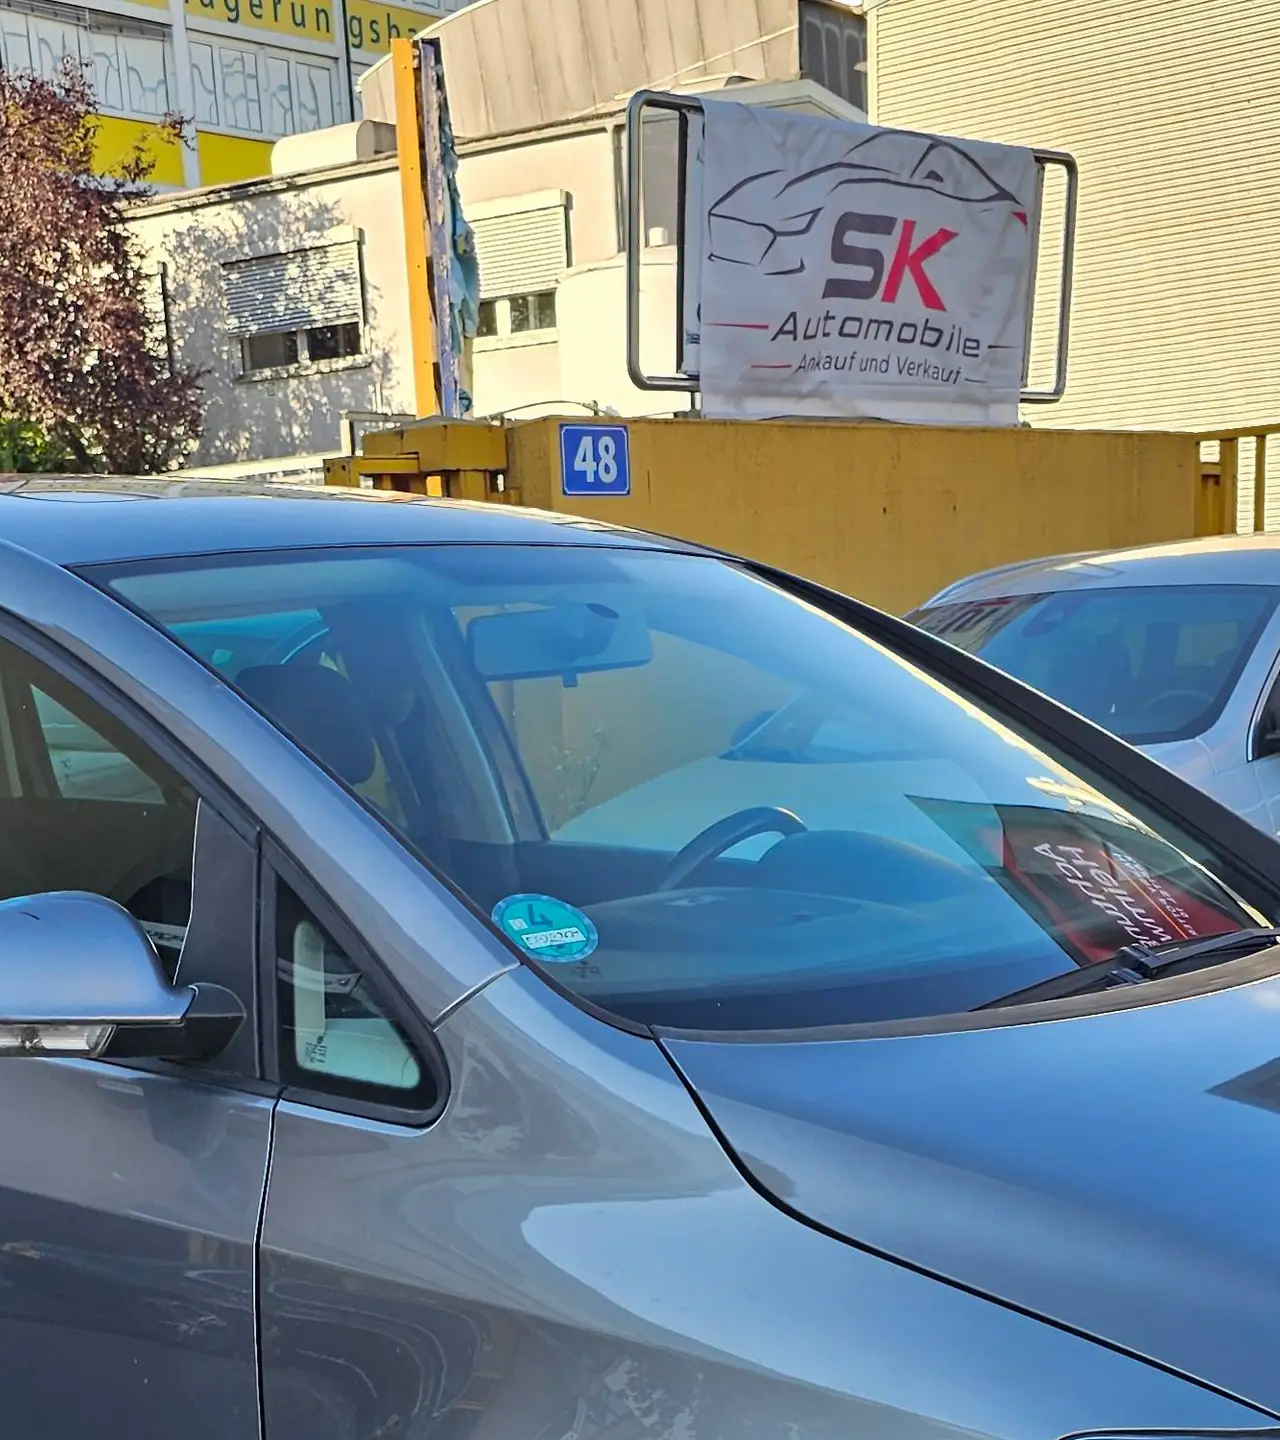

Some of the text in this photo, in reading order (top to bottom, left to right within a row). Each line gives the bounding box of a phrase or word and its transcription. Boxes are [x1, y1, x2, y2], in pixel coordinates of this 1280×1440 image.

[821, 211, 959, 312] SK
[770, 310, 981, 358] Automobile
[795, 351, 961, 385] Ankauf und Verkauf
[574, 436, 618, 484] 48
